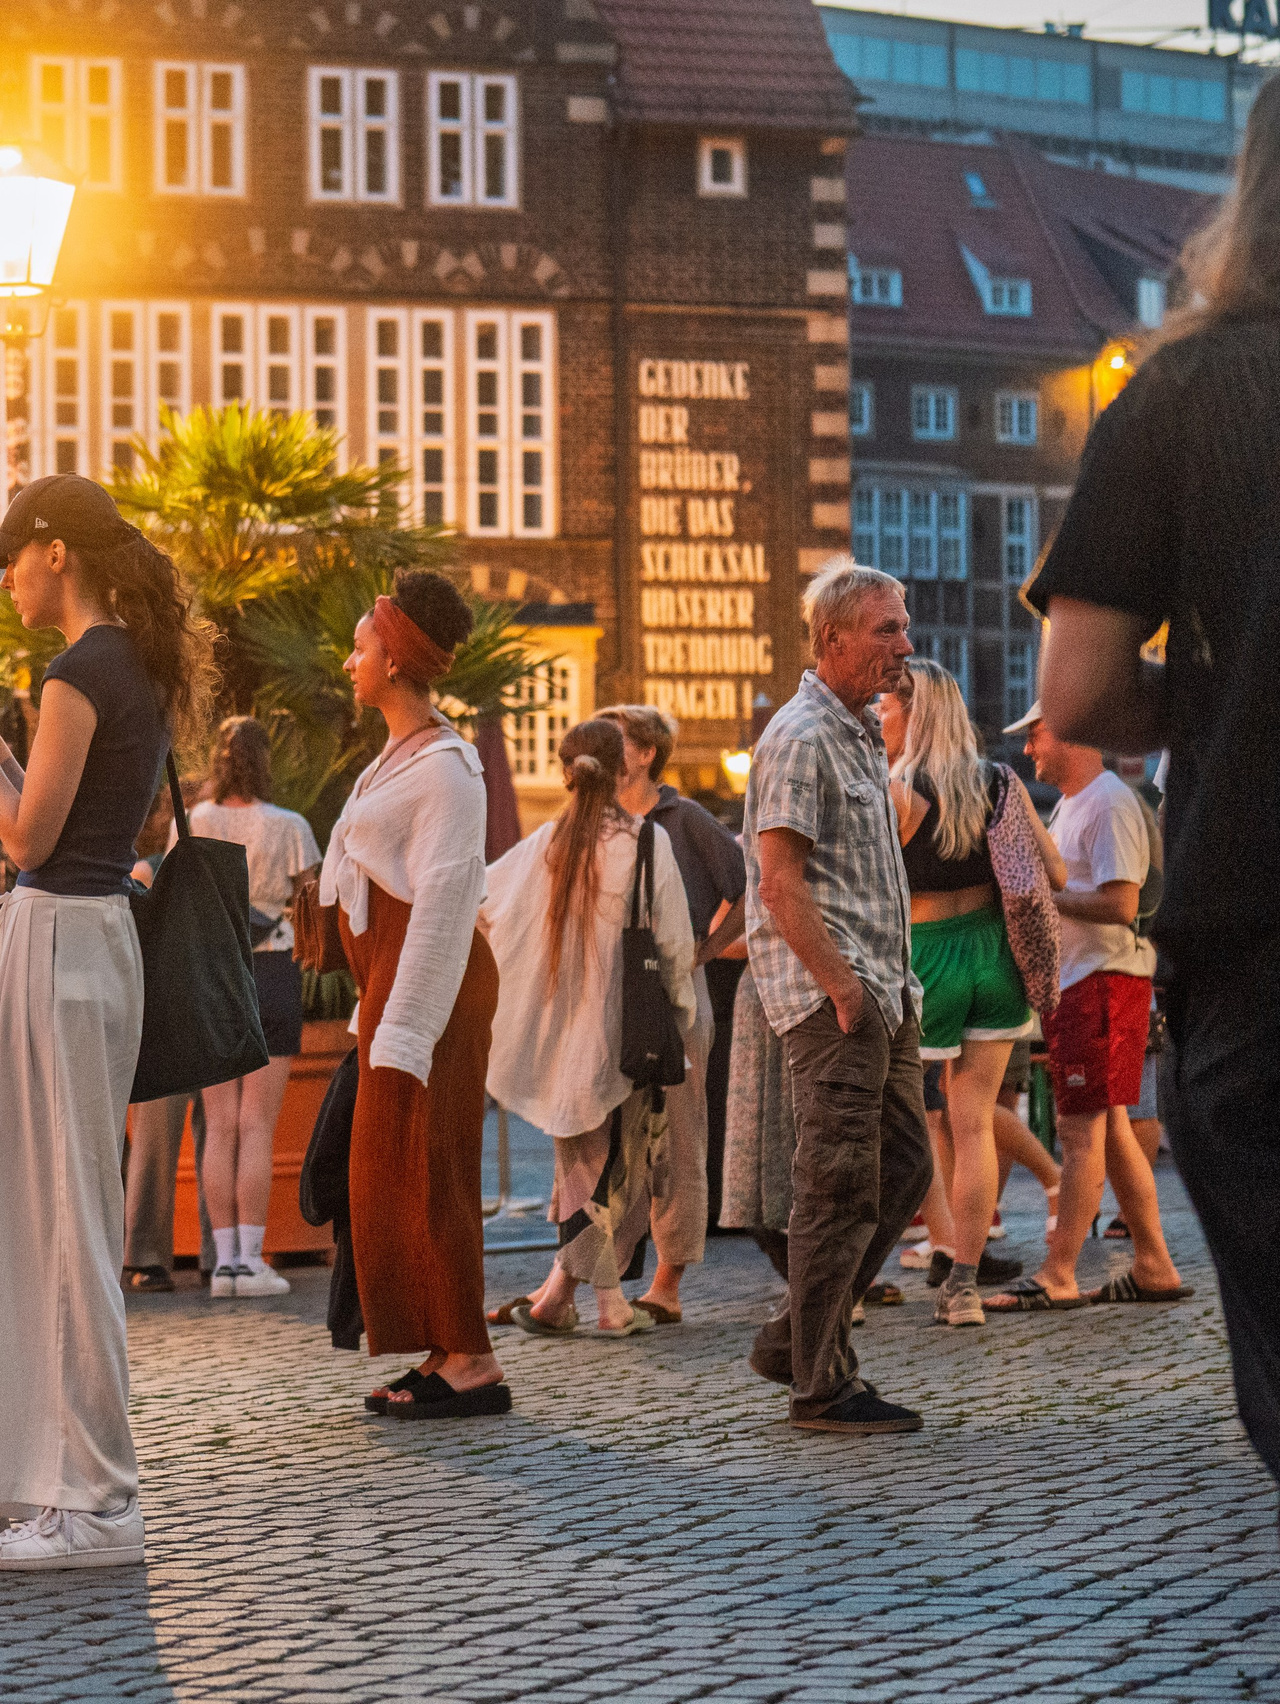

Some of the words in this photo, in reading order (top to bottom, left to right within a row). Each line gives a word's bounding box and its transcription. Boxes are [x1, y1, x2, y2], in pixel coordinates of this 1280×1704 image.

[639, 358, 751, 400] GEDENKE
[639, 405, 689, 444] DER
[640, 496, 682, 536] DIE
[687, 497, 735, 538] DAS
[641, 542, 770, 583] SCHICKSAL
[641, 588, 755, 628] UNSERER
[644, 633, 774, 675] TRENNUNG
